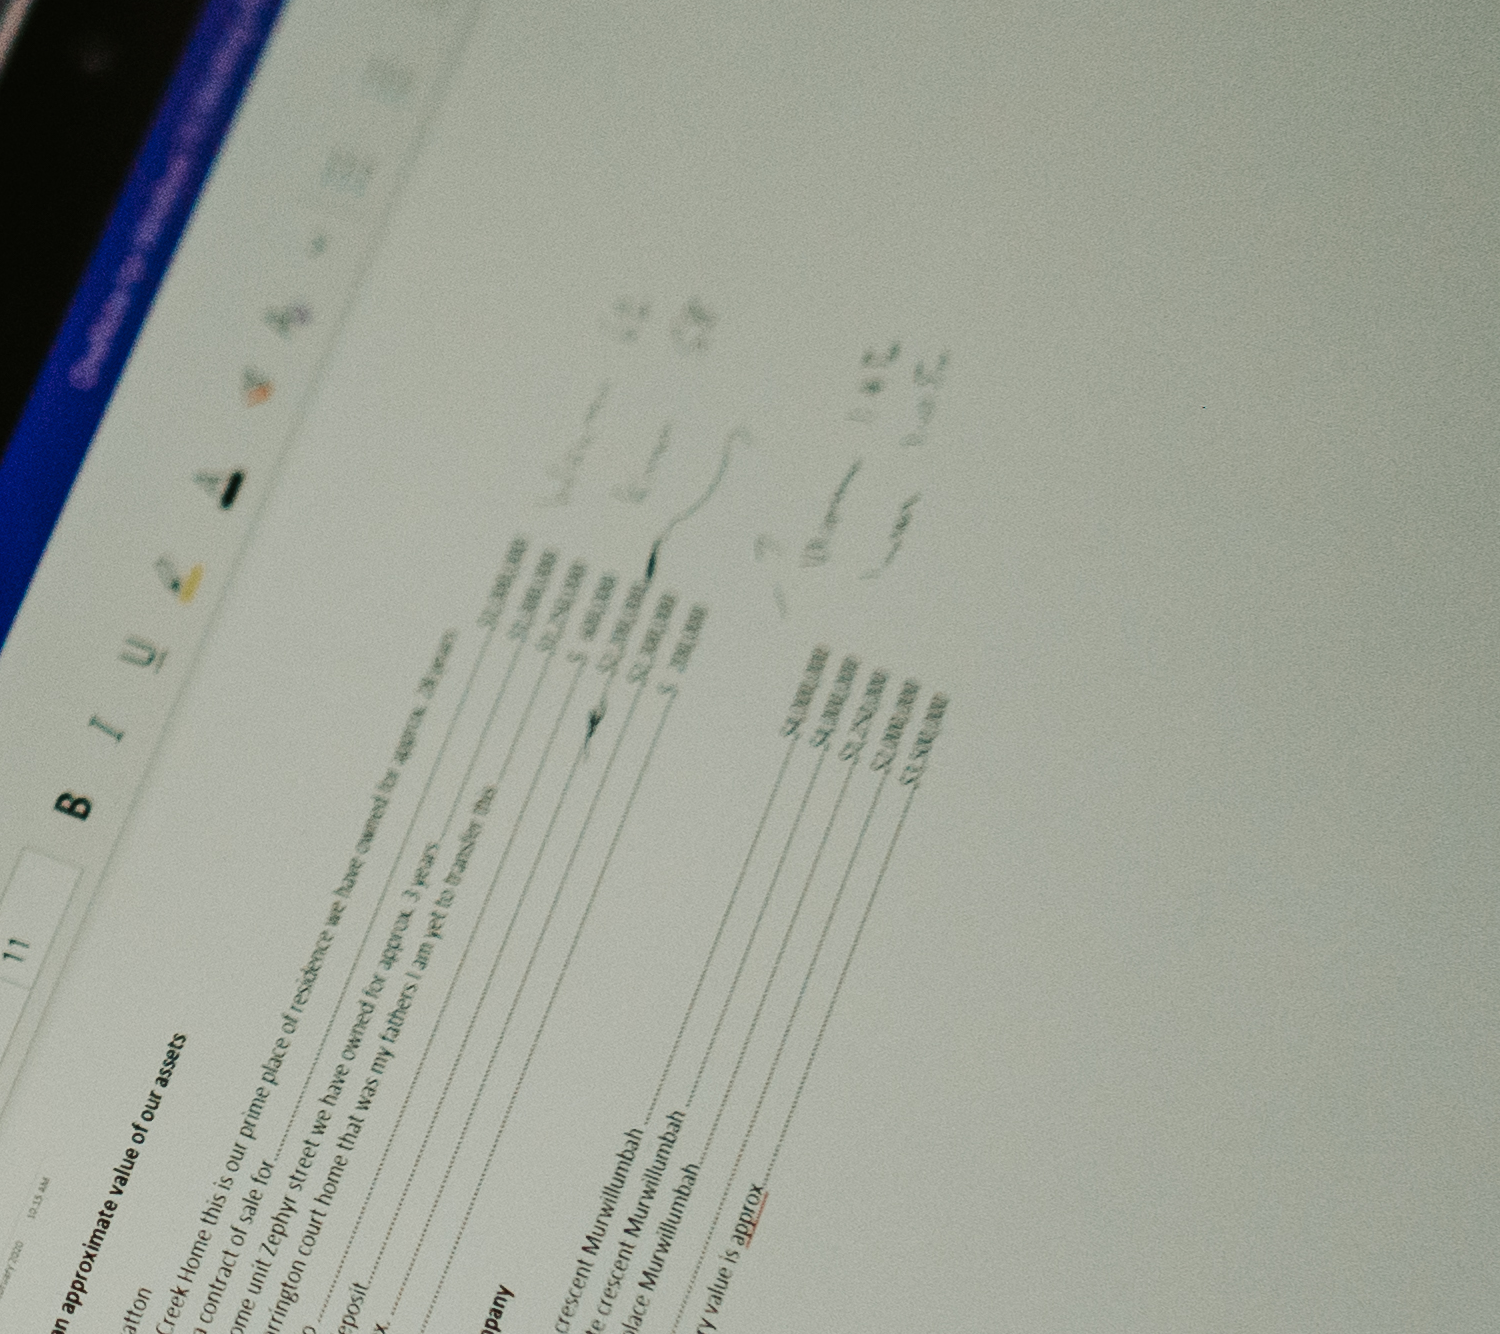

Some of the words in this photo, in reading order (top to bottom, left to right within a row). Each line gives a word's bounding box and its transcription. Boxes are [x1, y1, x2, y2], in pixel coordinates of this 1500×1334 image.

[119, 637, 168, 671] U
[87, 714, 125, 743] I
[53, 791, 92, 821] B
[356, 794, 389, 853] owned
[333, 856, 364, 898] have
[401, 888, 420, 901] 3
[326, 900, 345, 926] we
[433, 888, 455, 908] to
[426, 910, 446, 939] yet
[1, 937, 29, 962] 11
[413, 941, 433, 970] am
[289, 929, 333, 1012] residence
[362, 973, 386, 998] for
[404, 970, 422, 981] I
[281, 1012, 299, 1035] of
[341, 999, 375, 1061] owned
[379, 983, 417, 1043] fathers
[260, 1036, 290, 1086] place
[370, 1046, 394, 1074] my
[318, 1063, 349, 1106] have
[356, 1078, 379, 1111] was
[109, 1147, 139, 1195] value
[130, 1121, 148, 1145] of
[140, 1089, 162, 1122] our
[155, 1033, 186, 1088] assets
[238, 1085, 269, 1140] prime
[311, 1108, 331, 1135] we
[336, 1114, 364, 1151] that
[225, 1141, 247, 1173] our
[288, 1138, 319, 1190] street
[214, 1175, 234, 1191] is
[313, 1154, 348, 1206] home
[199, 1194, 226, 1226] this
[260, 1195, 297, 1256] Zephyr
[297, 1208, 327, 1256] court
[176, 1228, 210, 1283] Home
[199, 1249, 238, 1324] contract
[229, 1224, 247, 1247] of
[239, 1188, 262, 1222] sale
[247, 1258, 271, 1295] unit
[597, 1240, 634, 1316] crescent
[704, 1266, 731, 1314] value
[719, 1249, 740, 1264] is
[554, 1257, 593, 1334] crescent
